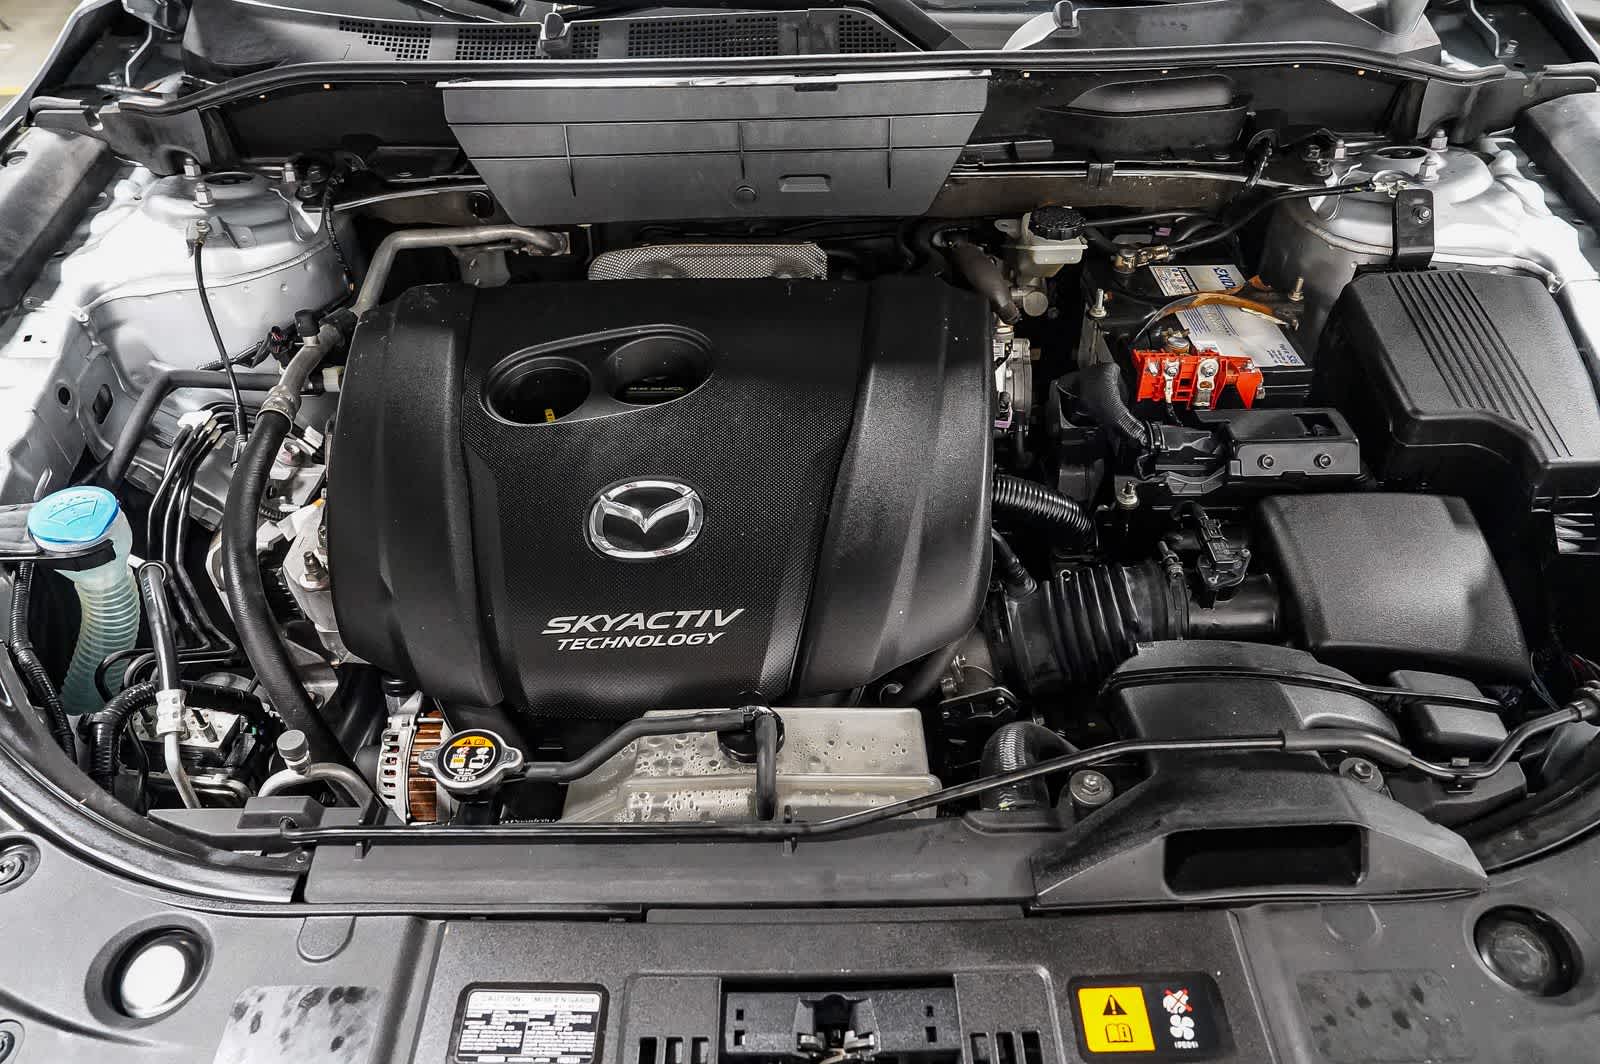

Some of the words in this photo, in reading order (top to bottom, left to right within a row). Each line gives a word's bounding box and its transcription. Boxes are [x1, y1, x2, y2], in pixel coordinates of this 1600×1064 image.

[1213, 266, 1237, 289] EXID
[541, 608, 745, 635] SKYACTIV
[557, 632, 727, 651] TECHNOLOGY
